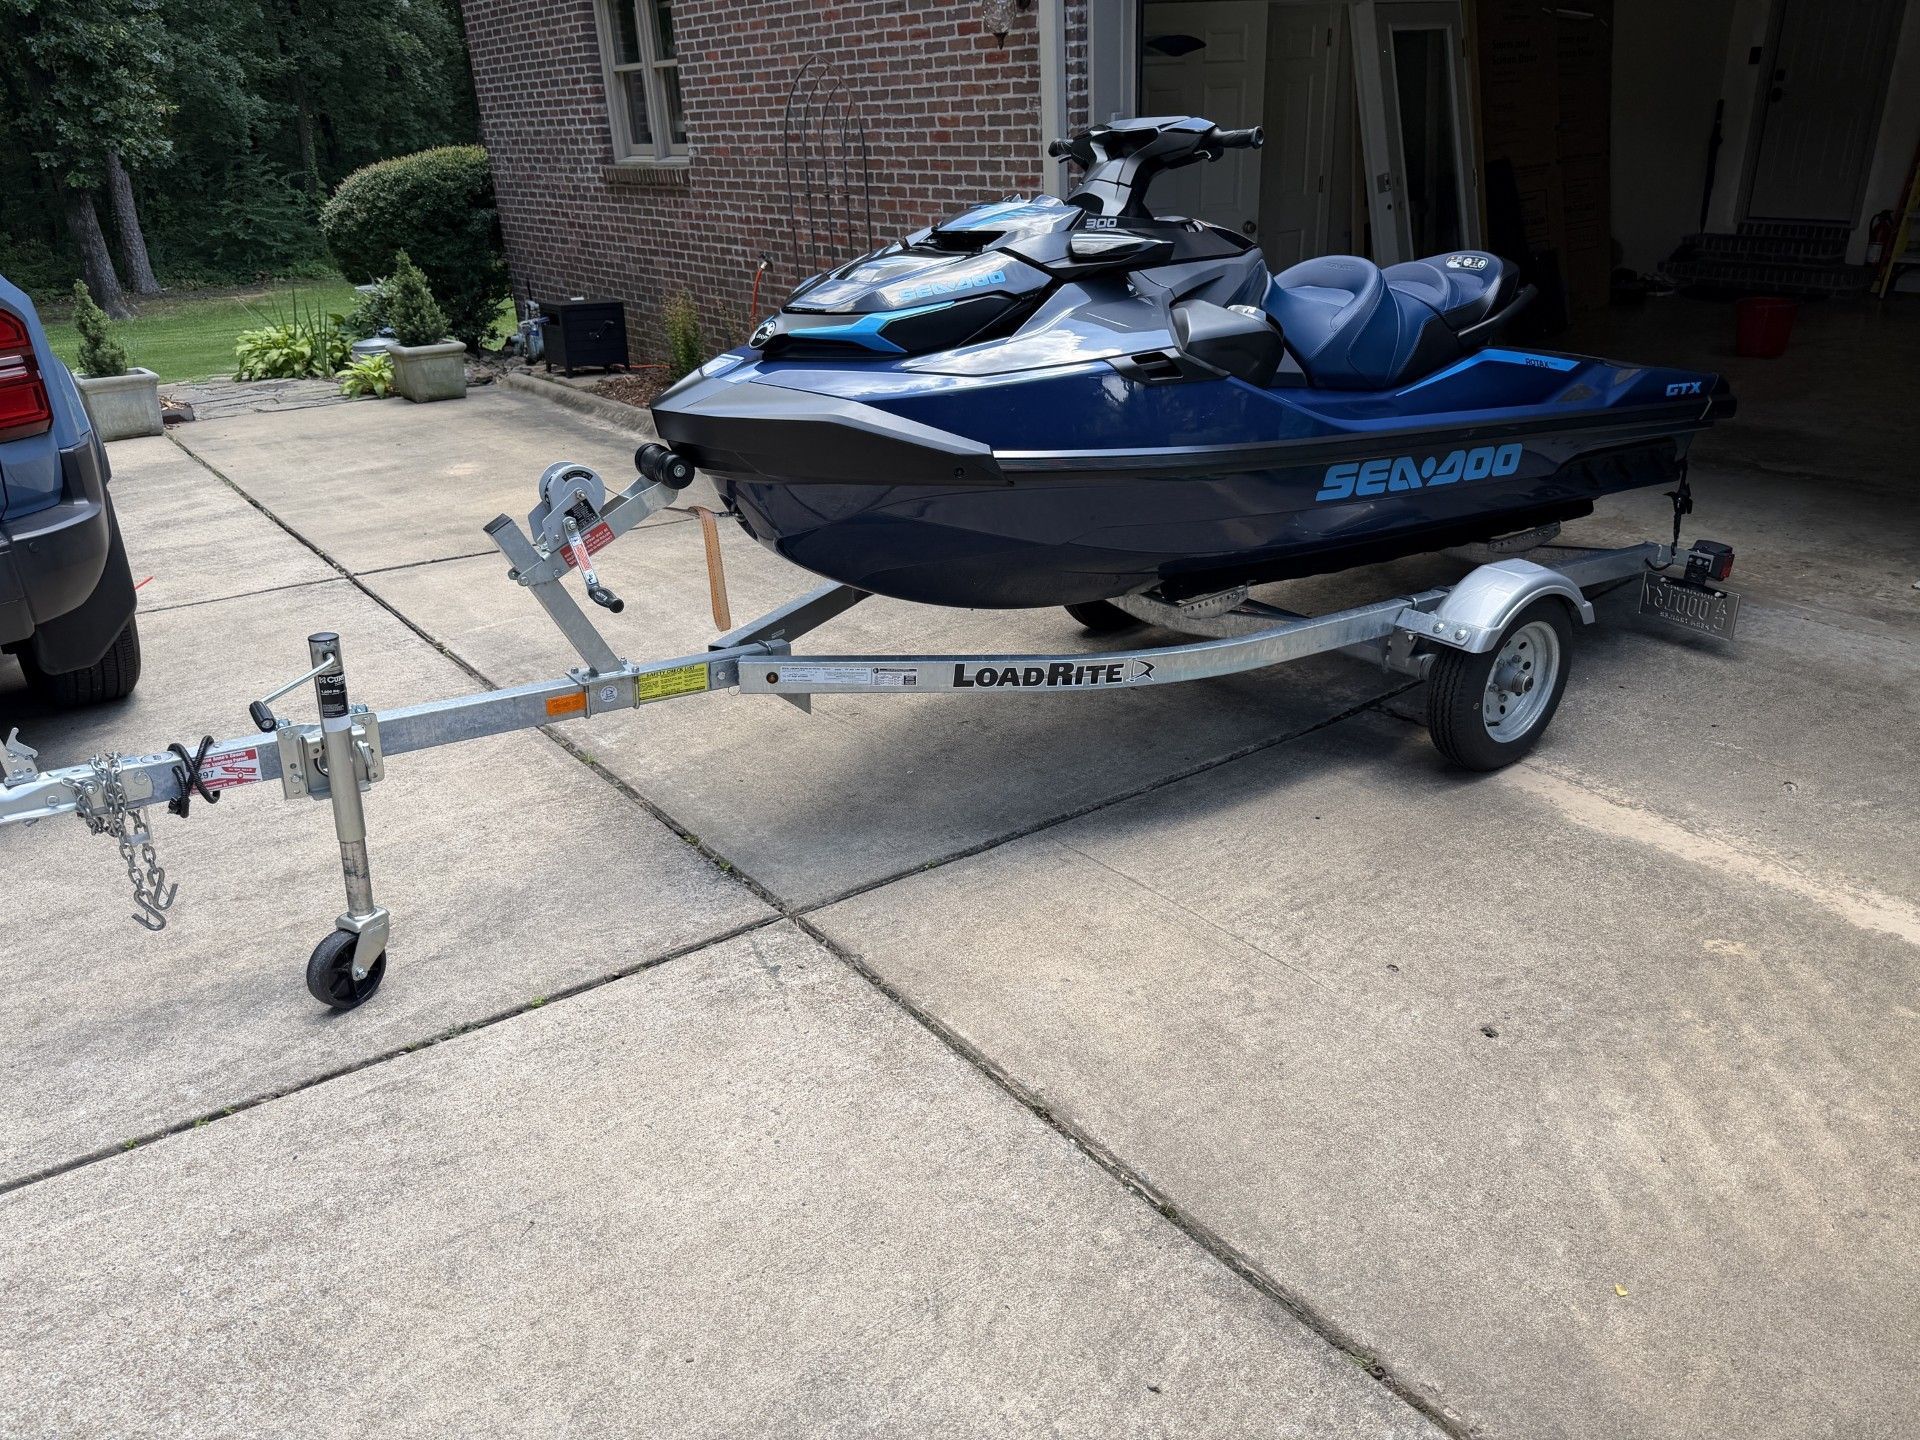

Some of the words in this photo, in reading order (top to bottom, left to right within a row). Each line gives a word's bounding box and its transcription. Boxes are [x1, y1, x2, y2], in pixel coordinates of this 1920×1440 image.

[1085, 218, 1118, 229] 300
[1525, 357, 1550, 369] ROTAX
[1666, 381, 1702, 397] GTX
